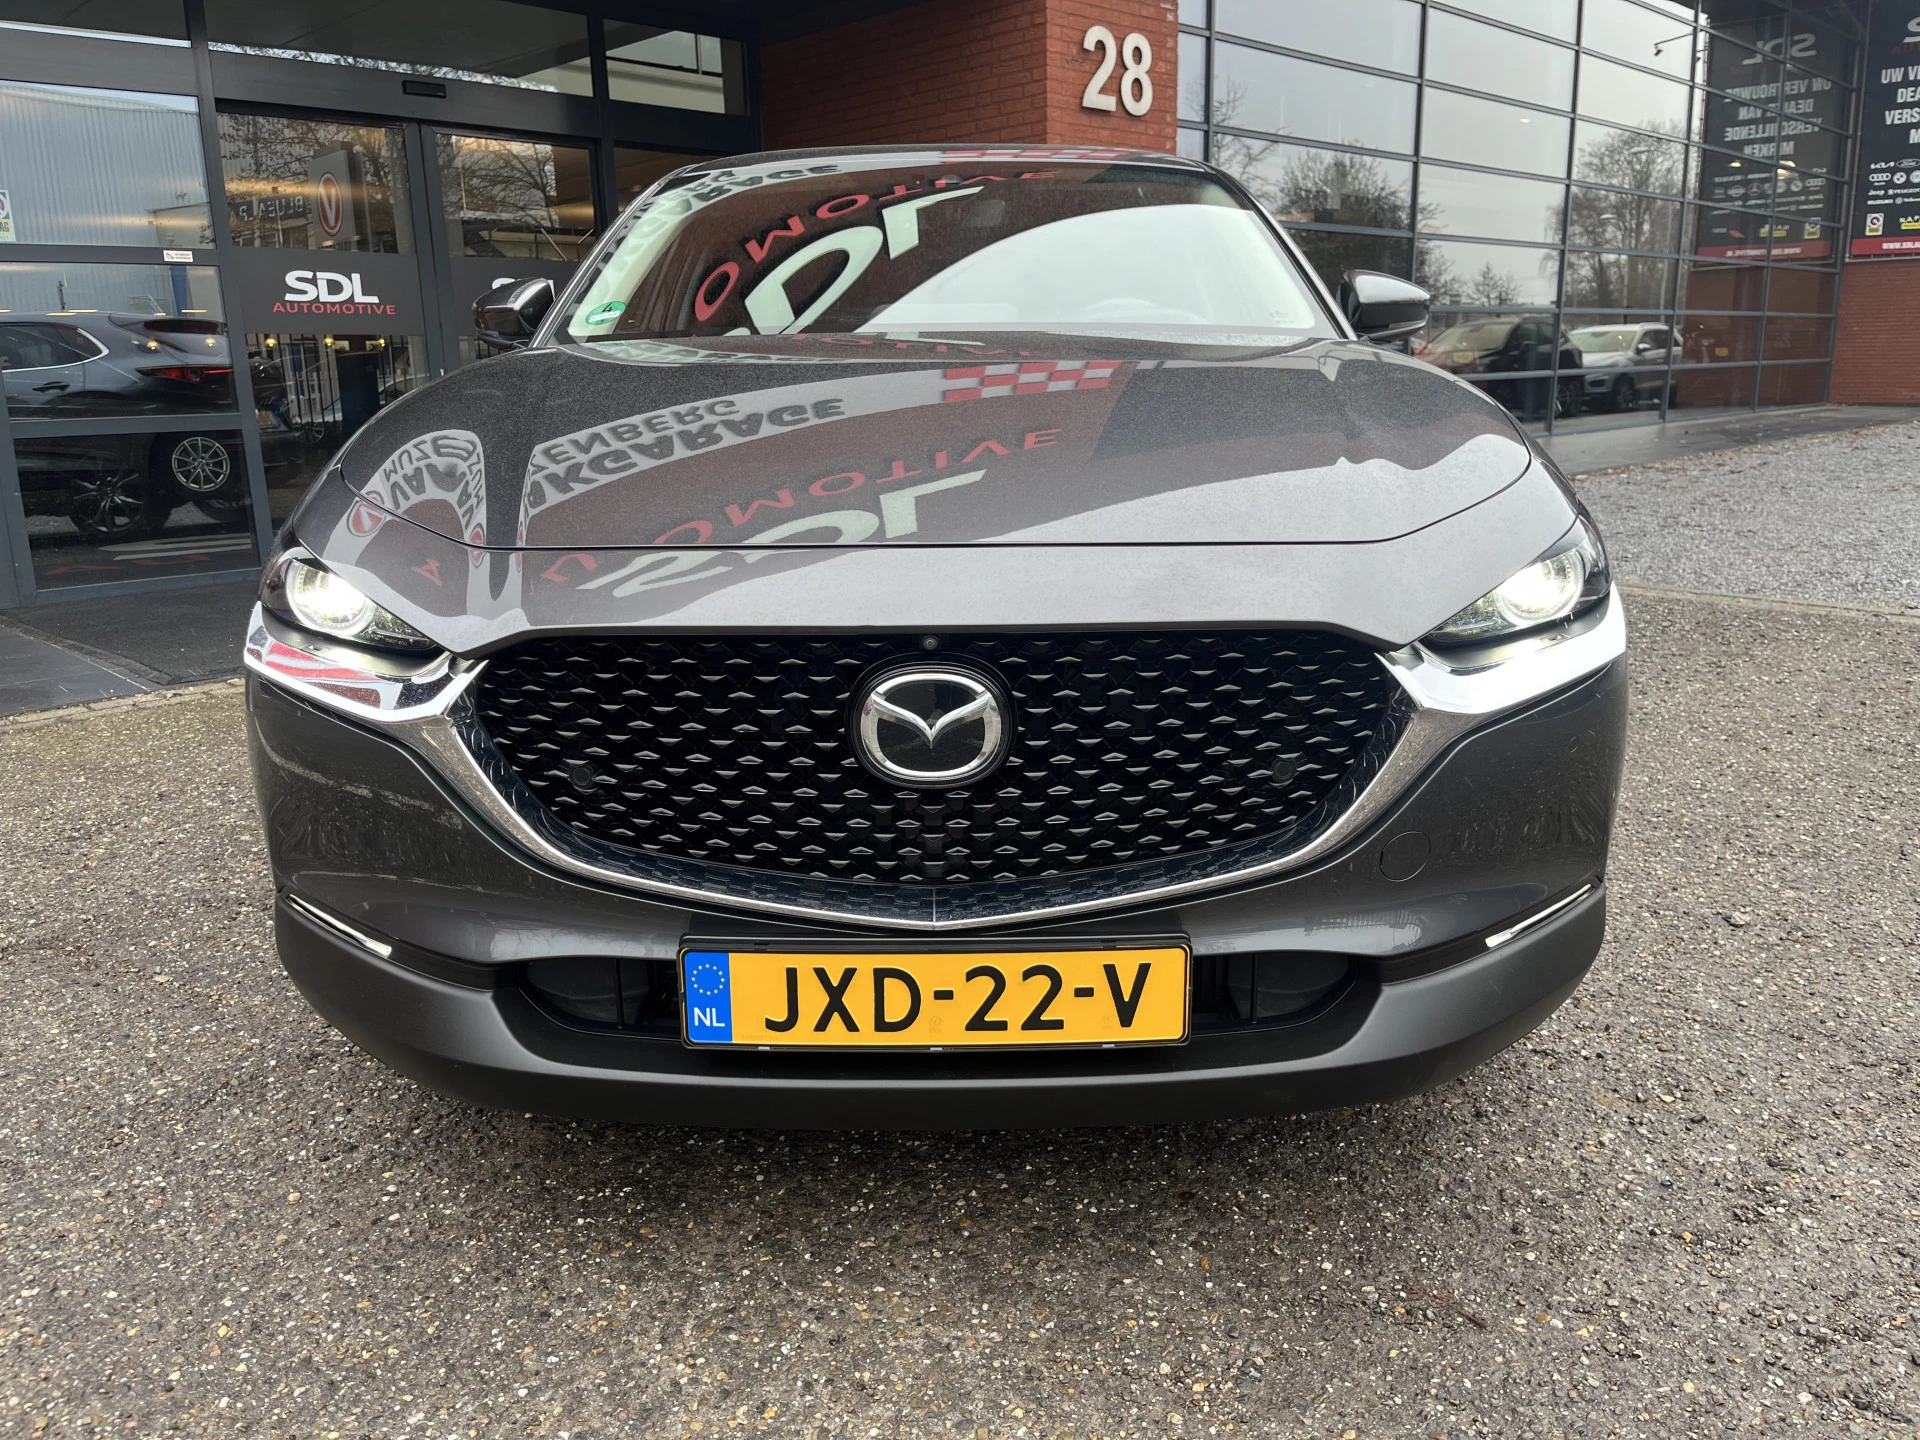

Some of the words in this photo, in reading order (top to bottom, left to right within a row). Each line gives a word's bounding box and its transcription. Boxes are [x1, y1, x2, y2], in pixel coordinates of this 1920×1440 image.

[1081, 25, 1153, 116] 28
[1881, 67, 1904, 84] UW
[1885, 107, 1920, 125] VERS
[285, 270, 380, 303] SDL
[273, 302, 396, 315] AUTOMOTIVE
[765, 962, 1152, 1033] JXD-22-V
[693, 1007, 725, 1027] NL
